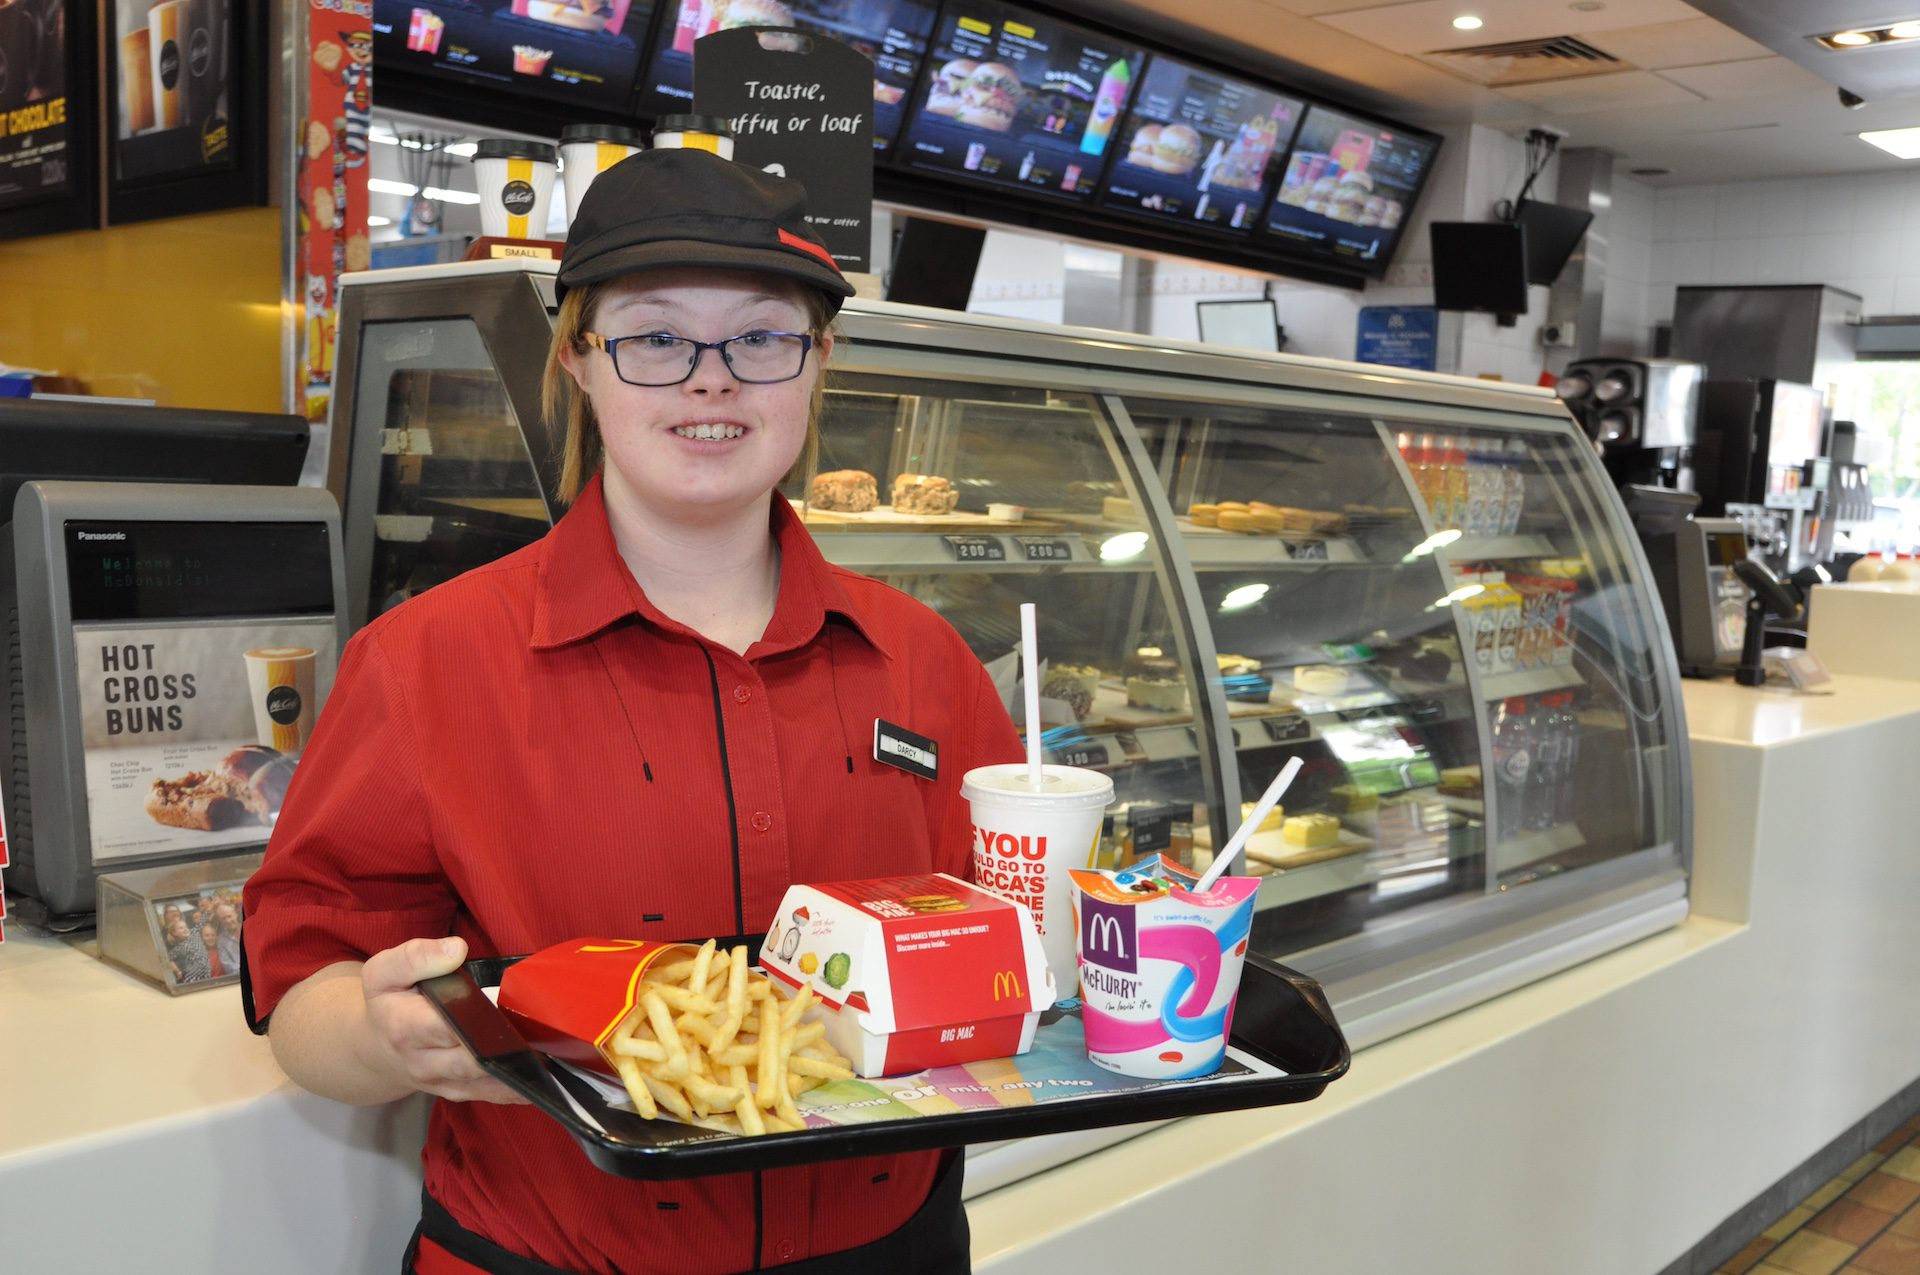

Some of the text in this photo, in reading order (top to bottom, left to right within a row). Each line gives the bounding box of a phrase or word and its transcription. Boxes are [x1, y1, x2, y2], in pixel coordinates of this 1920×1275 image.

[9, 97, 66, 136] CHOCOLATE
[729, 113, 863, 135] uffin or loaf
[505, 249, 538, 258] SMALL
[78, 532, 126, 541] Panasonic
[102, 644, 155, 673] HOT
[104, 673, 197, 704] CROSS
[107, 705, 183, 736] BUNS
[897, 744, 917, 759] DARCY
[980, 828, 1047, 861] YOU
[998, 860, 1019, 873] GO
[1023, 863, 1045, 874] TO
[976, 866, 1046, 894] ACCA'S
[861, 899, 899, 912] BIG
[876, 907, 916, 919] MAC
[895, 925, 990, 942] WHAT MAKES YOUR BIG MAC SO UNIQUE?
[896, 944, 918, 953] Discover
[940, 1025, 975, 1043] BIG MAC
[891, 1084, 940, 1101] or
[949, 1084, 992, 1094] mix
[1001, 1080, 1044, 1091] any
[1047, 1079, 1094, 1087] two
